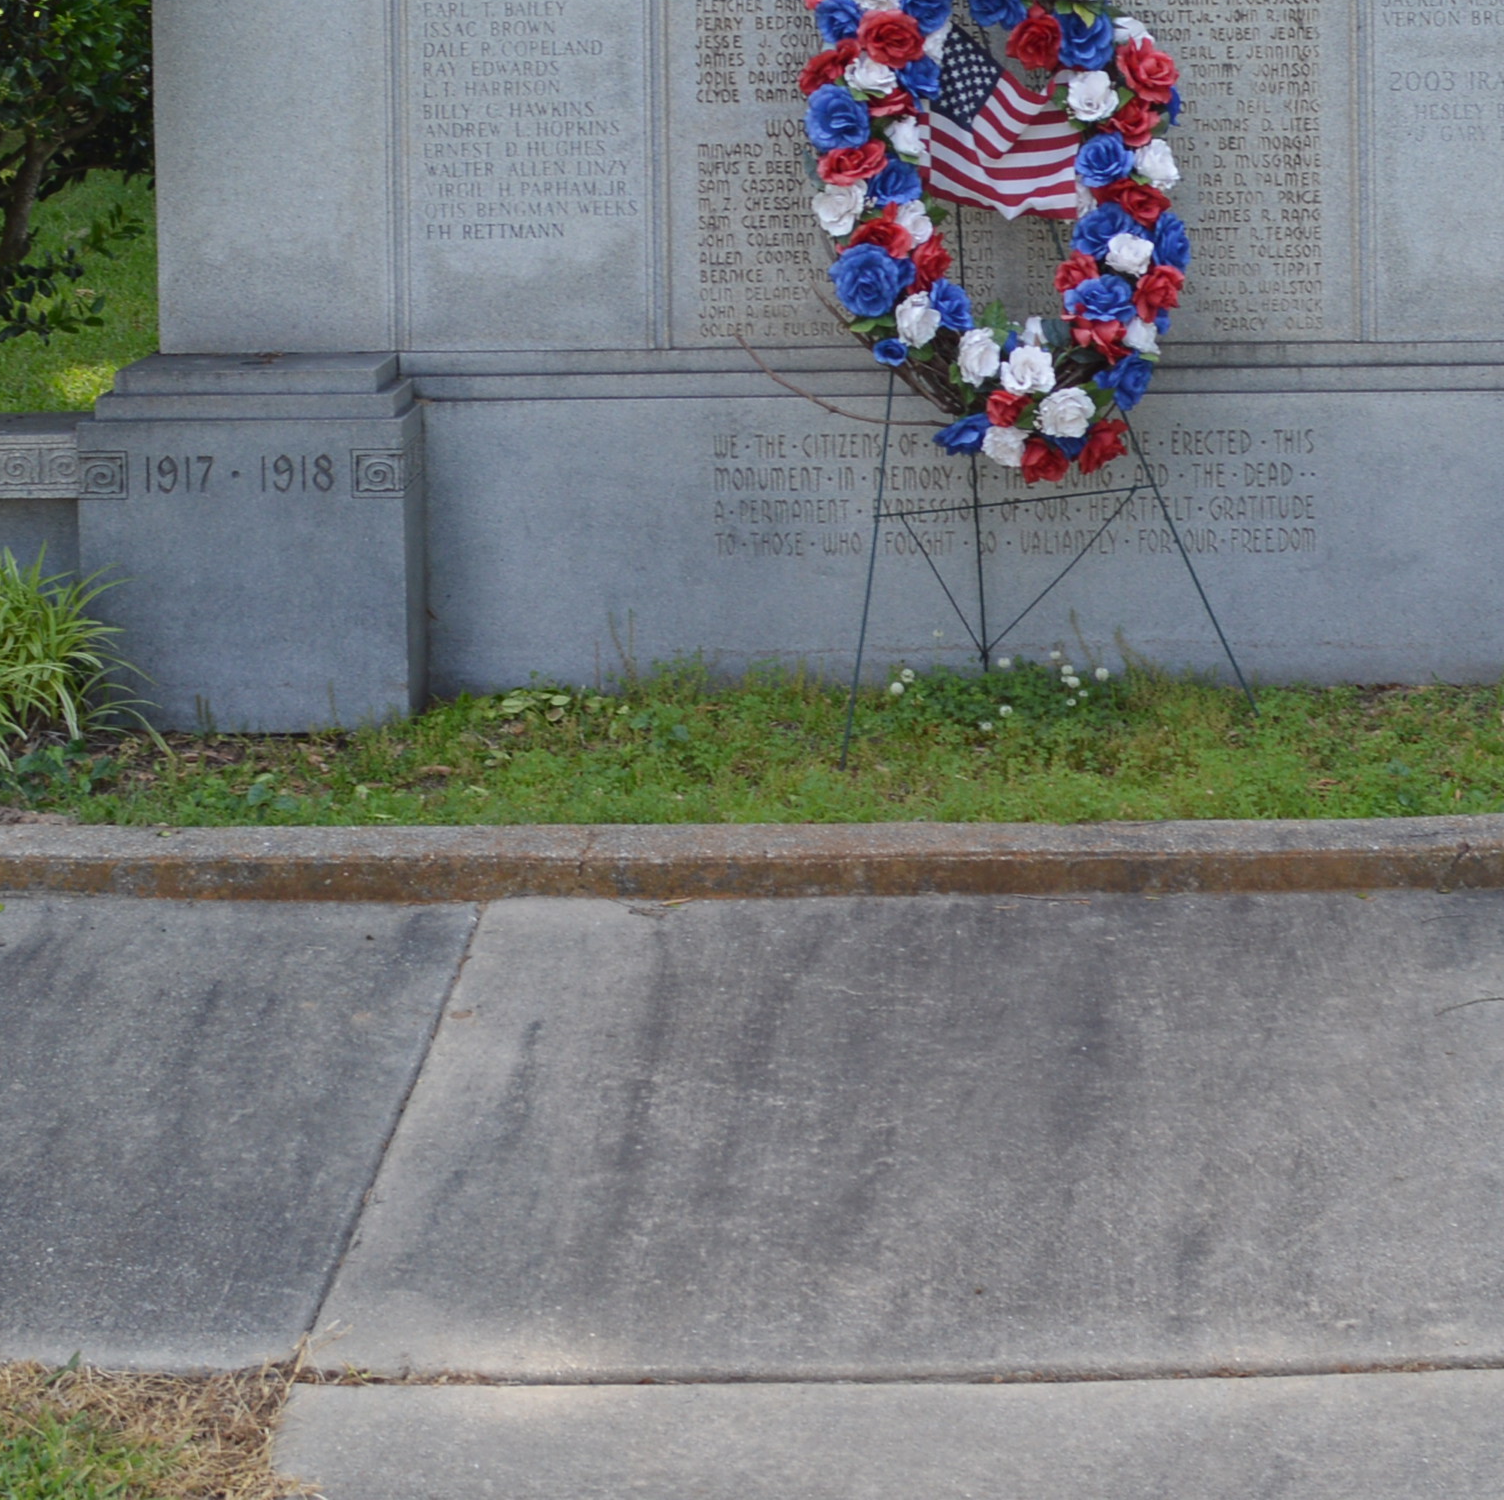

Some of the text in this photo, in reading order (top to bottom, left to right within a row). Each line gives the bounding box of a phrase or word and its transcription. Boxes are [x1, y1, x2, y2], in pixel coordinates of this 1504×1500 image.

[423, 2, 469, 17] EARL
[505, 1, 565, 17] BAILEY
[1225, 9, 1319, 22] JOHN IRVIN
[696, 17, 743, 31] PERRY
[1382, 11, 1460, 27] VERNON
[424, 21, 556, 38] ISSAC BROWN
[1210, 26, 1320, 41] REUBEN JEANES
[423, 40, 603, 57] DALE COPELAND
[695, 35, 771, 49] JESSE J.
[696, 53, 744, 67] JAMES
[1181, 45, 1320, 60] EARL E. JENNINGS
[423, 61, 560, 77] RAY EDWARDS
[1190, 63, 1319, 78] TOMMY JOHNSON
[696, 71, 736, 86] JODIE
[1390, 71, 1455, 91] 2003
[465, 80, 560, 96] HARRISON
[696, 89, 740, 103] CLYDE
[423, 102, 595, 120] BILLY HAWKINS
[1237, 100, 1320, 113] NEIL KING
[1415, 104, 1483, 120] HESLEY
[426, 122, 500, 138] ANDREW
[536, 120, 620, 136] HOPKINS
[1193, 118, 1320, 131] THOMAS LITES
[424, 140, 606, 158] ERNEST HUGHES
[1219, 136, 1320, 150] BEN MORGAN
[698, 161, 740, 176] RUFUS
[748, 161, 761, 175] E.
[1214, 154, 1321, 168] D. MUSGRAVE
[424, 160, 629, 178] WALTER ALLEN LINZY
[698, 179, 807, 194] SAM CASSADY
[1198, 172, 1320, 187] IRA D. PALMER
[425, 182, 483, 197] VIRGIL
[698, 197, 716, 211] M.
[1198, 190, 1322, 205] PRESTON PRICE
[425, 203, 466, 219] OTIS
[578, 200, 638, 217] WEEKS
[1199, 209, 1321, 223] JAMES R. RANG
[698, 214, 818, 230] SAM CLEMENTS
[462, 223, 565, 239] RETTMANN
[1265, 226, 1321, 240] TEAGUE
[698, 232, 815, 247] JOHN COLEMAN
[699, 251, 812, 266] ALLEN COOPER
[1250, 244, 1321, 258] TOLLESON
[700, 269, 763, 284] BERNICE
[1273, 263, 1322, 276] TIPPIT
[700, 286, 811, 302] OLIN DELANEY
[1258, 281, 1322, 294] WALSTON
[699, 305, 735, 319] JOHN
[1195, 299, 1323, 313] JAMES HEDRICK
[700, 323, 754, 337] GOLDEN
[1213, 317, 1268, 331] PEARCY
[713, 434, 739, 458] WE
[755, 434, 787, 458] THE
[802, 433, 884, 458] CITIZENS
[899, 434, 919, 456] OF
[1171, 431, 1252, 455] ERECTED
[1273, 429, 1315, 454] THIS
[147, 454, 334, 493] 1917 1918
[714, 462, 1293, 491] MONUMENT IN MEMORY OF AND THE DEAD
[714, 495, 1315, 524] A PERMANENT EXPRESSION OF OUR HEARTFELT GRATITUDE
[714, 532, 736, 555] TO
[751, 531, 804, 556] THOSE
[823, 531, 862, 555] WHO
[885, 530, 955, 556] FOUGHT
[1020, 529, 1118, 555] VALIANTLY
[1138, 529, 1170, 554] FOR
[1184, 528, 1218, 553] OUR
[1230, 527, 1316, 553] FREEDOM
